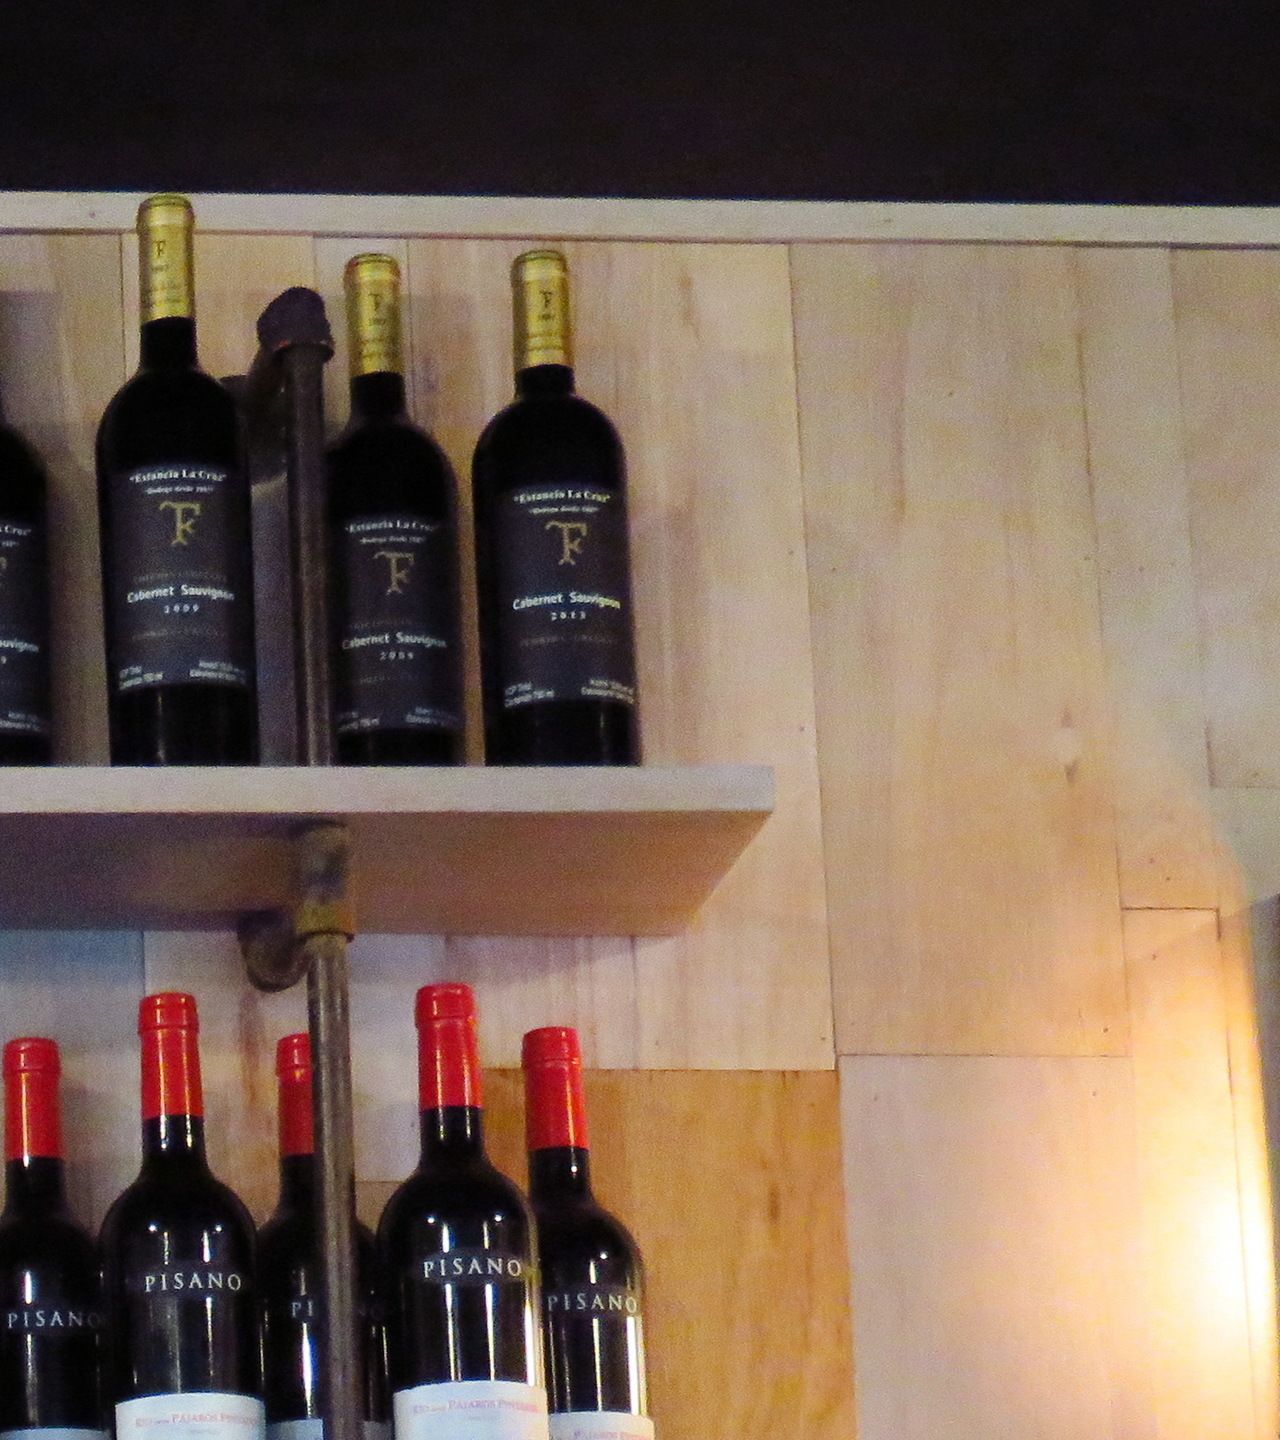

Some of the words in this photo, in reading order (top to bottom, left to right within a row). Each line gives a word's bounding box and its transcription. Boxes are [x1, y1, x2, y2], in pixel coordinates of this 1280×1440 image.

[182, 469, 196, 479] La
[567, 489, 582, 499] La
[126, 587, 175, 604] Cabernet
[180, 585, 235, 601] Sauvignon
[512, 592, 566, 611] Cabernet
[569, 590, 621, 609] Sauvignon
[423, 1258, 523, 1279] PISANO
[144, 1272, 243, 1293] PISANO
[548, 1293, 638, 1314] PISANO
[7, 1310, 100, 1330] PISANO
